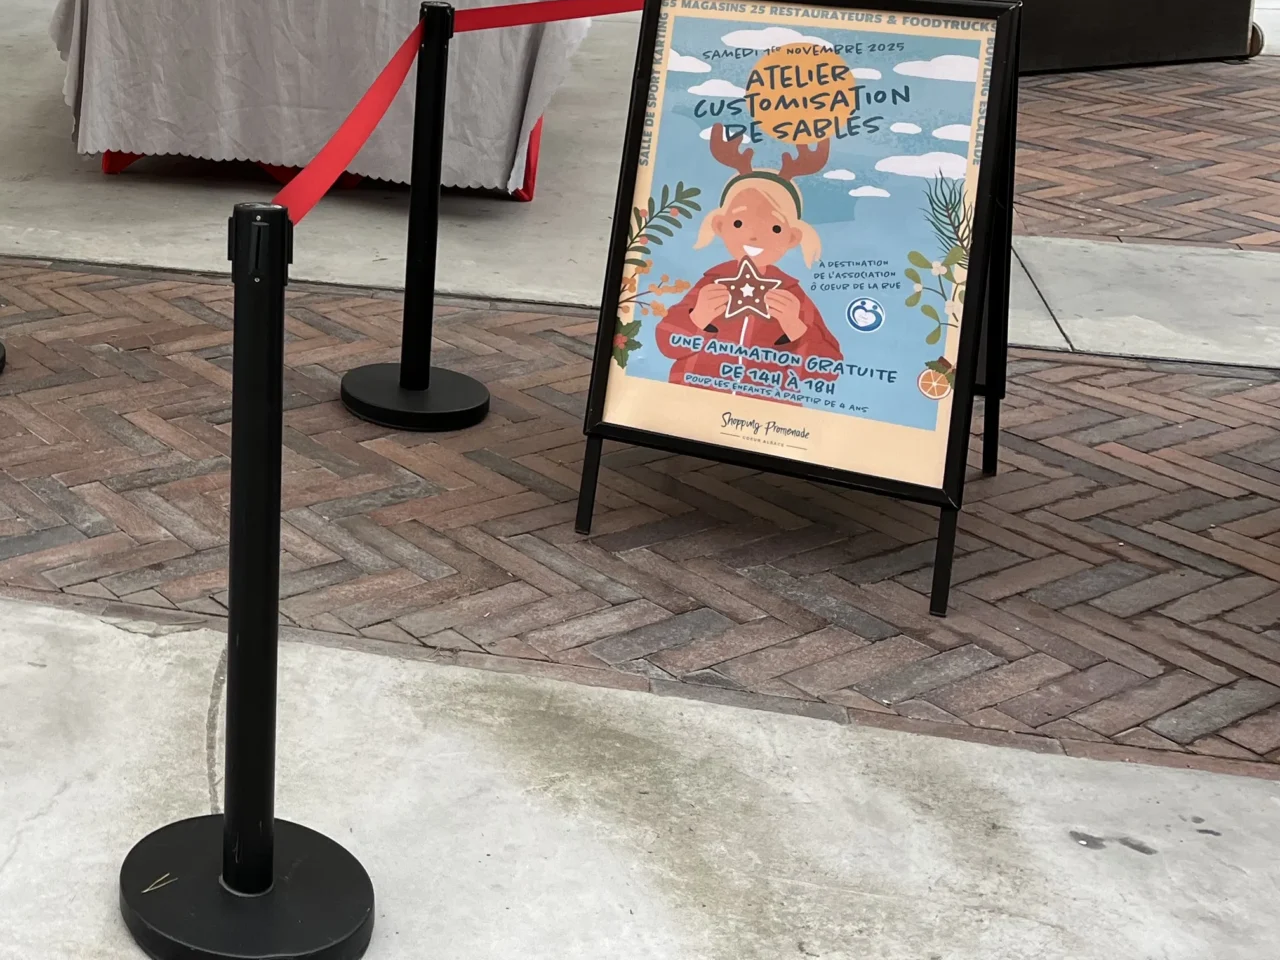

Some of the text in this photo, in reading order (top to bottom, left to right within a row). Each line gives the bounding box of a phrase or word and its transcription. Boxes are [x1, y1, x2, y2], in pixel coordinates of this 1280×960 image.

[681, 0, 747, 14] MAGASINS
[750, 4, 766, 15] 25
[770, 6, 883, 24] RESTAURATEURS
[886, 15, 897, 25] &
[902, 16, 997, 33] FOODTRUCKS
[703, 48, 758, 60] SAMEDI
[786, 43, 863, 56] NOVEMBRE
[868, 42, 905, 53] 2025
[639, 12, 668, 166] SALLE DE SPORT KARTING
[746, 63, 850, 90] ATELIER
[694, 85, 911, 118] CUSTOMISATION
[724, 109, 884, 143] DE SABLÉS
[813, 271, 896, 280] DE L'ASSOCIATION
[828, 260, 889, 268] DESTINATION
[810, 282, 816, 291] Ô
[820, 283, 849, 291] COEUR
[881, 282, 901, 290] RUE
[671, 334, 898, 384] UNE ANIMATION GRATUITE
[685, 374, 712, 385] POUR
[714, 379, 730, 389] LES
[732, 382, 772, 396] ENFANTS
[774, 387, 782, 398] À
[783, 392, 821, 405] PARTIR
[824, 400, 837, 408] DE
[848, 405, 869, 413] ANS
[721, 364, 835, 395] DE 14H À 18H
[721, 411, 810, 439] Shopping Promenade
